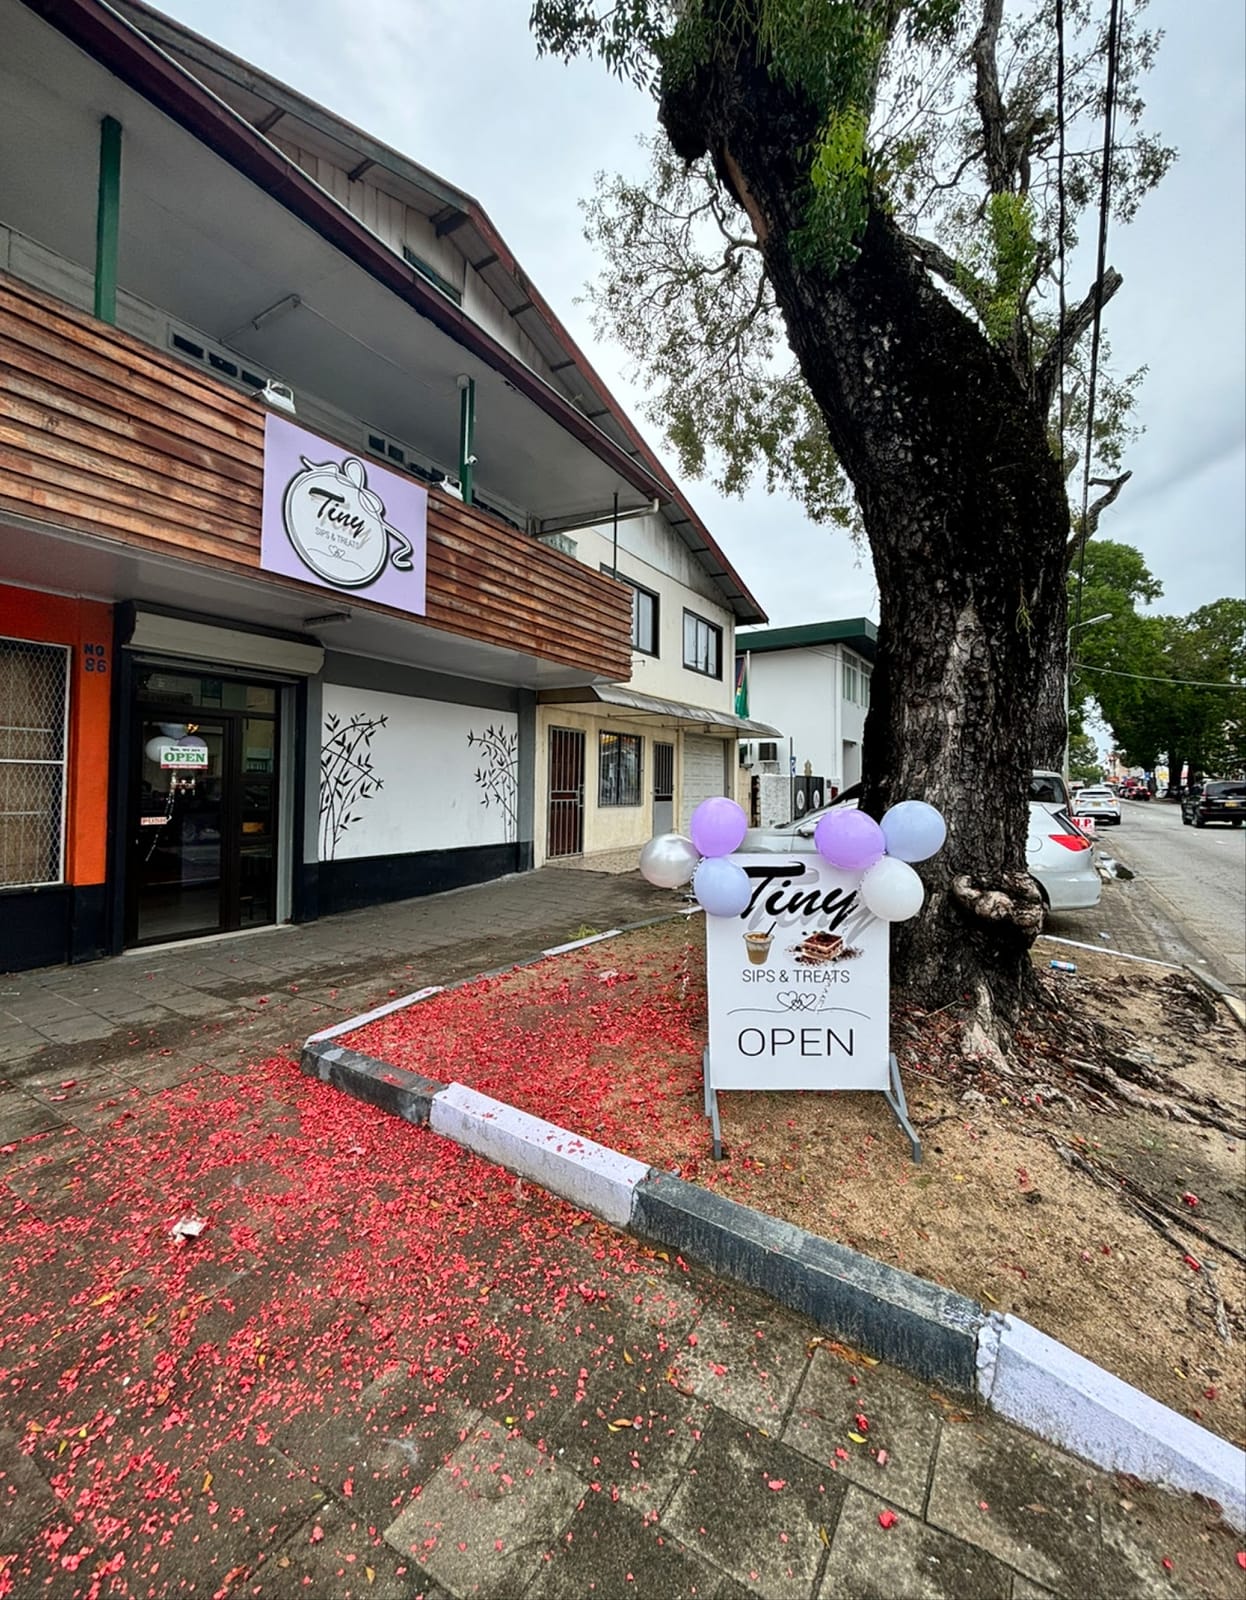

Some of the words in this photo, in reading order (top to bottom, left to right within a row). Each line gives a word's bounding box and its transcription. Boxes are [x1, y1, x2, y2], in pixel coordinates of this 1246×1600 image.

[308, 487, 365, 539] Tiny
[314, 526, 330, 540] SIPS
[337, 534, 361, 550] TREATS
[83, 643, 105, 657] NO
[84, 657, 107, 672] 86
[164, 752, 205, 762] OPEN
[741, 862, 859, 932] Tiny
[742, 969, 776, 984] SIPS
[779, 969, 790, 984] &
[793, 969, 851, 984] TREATS
[738, 1027, 854, 1057] OPEN
